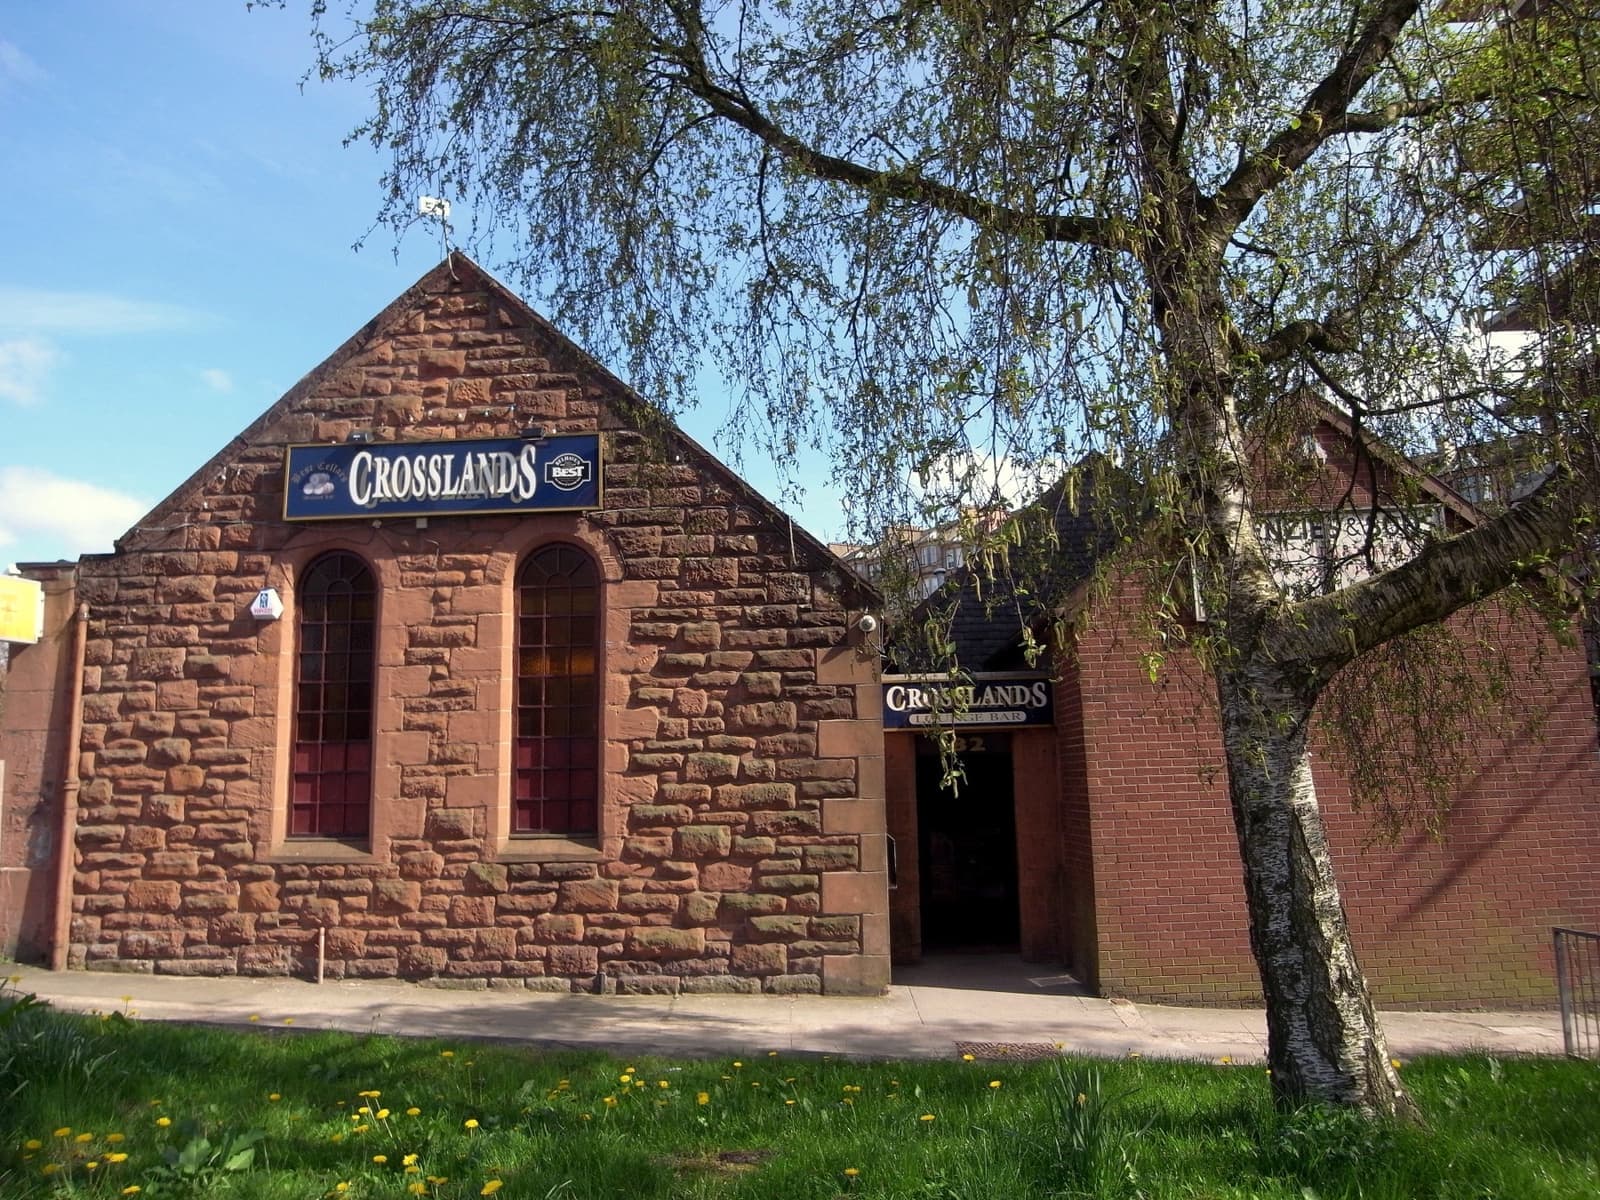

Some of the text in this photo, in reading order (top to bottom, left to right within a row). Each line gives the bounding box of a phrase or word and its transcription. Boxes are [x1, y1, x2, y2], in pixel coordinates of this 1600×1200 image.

[349, 444, 537, 505] CROSSLANDS
[552, 465, 584, 477] BEST
[990, 712, 1022, 721] BAR
